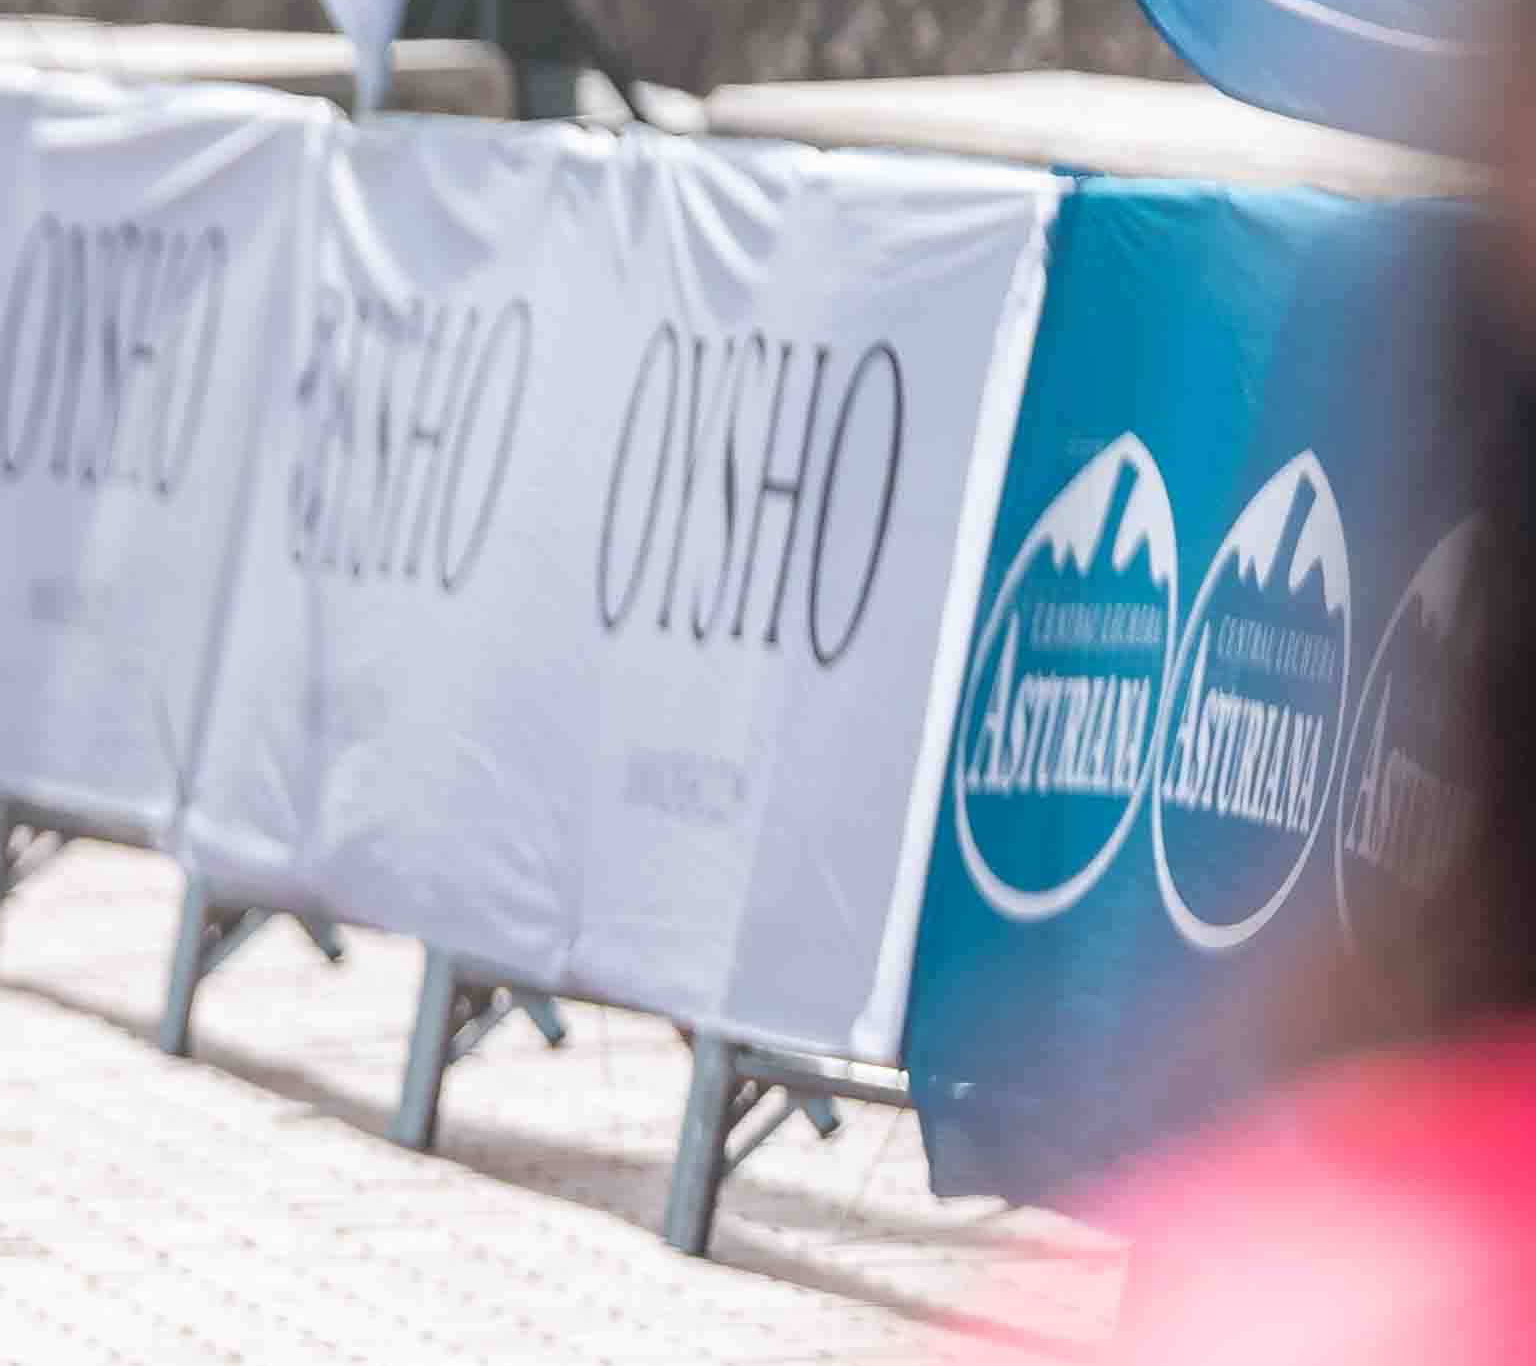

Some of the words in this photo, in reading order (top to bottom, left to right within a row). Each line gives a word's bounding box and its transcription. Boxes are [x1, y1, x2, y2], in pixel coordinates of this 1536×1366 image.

[596, 318, 904, 669] OYSHO
[966, 610, 1150, 795] ASTURIANA
[1164, 620, 1323, 833] ASTURIANA
